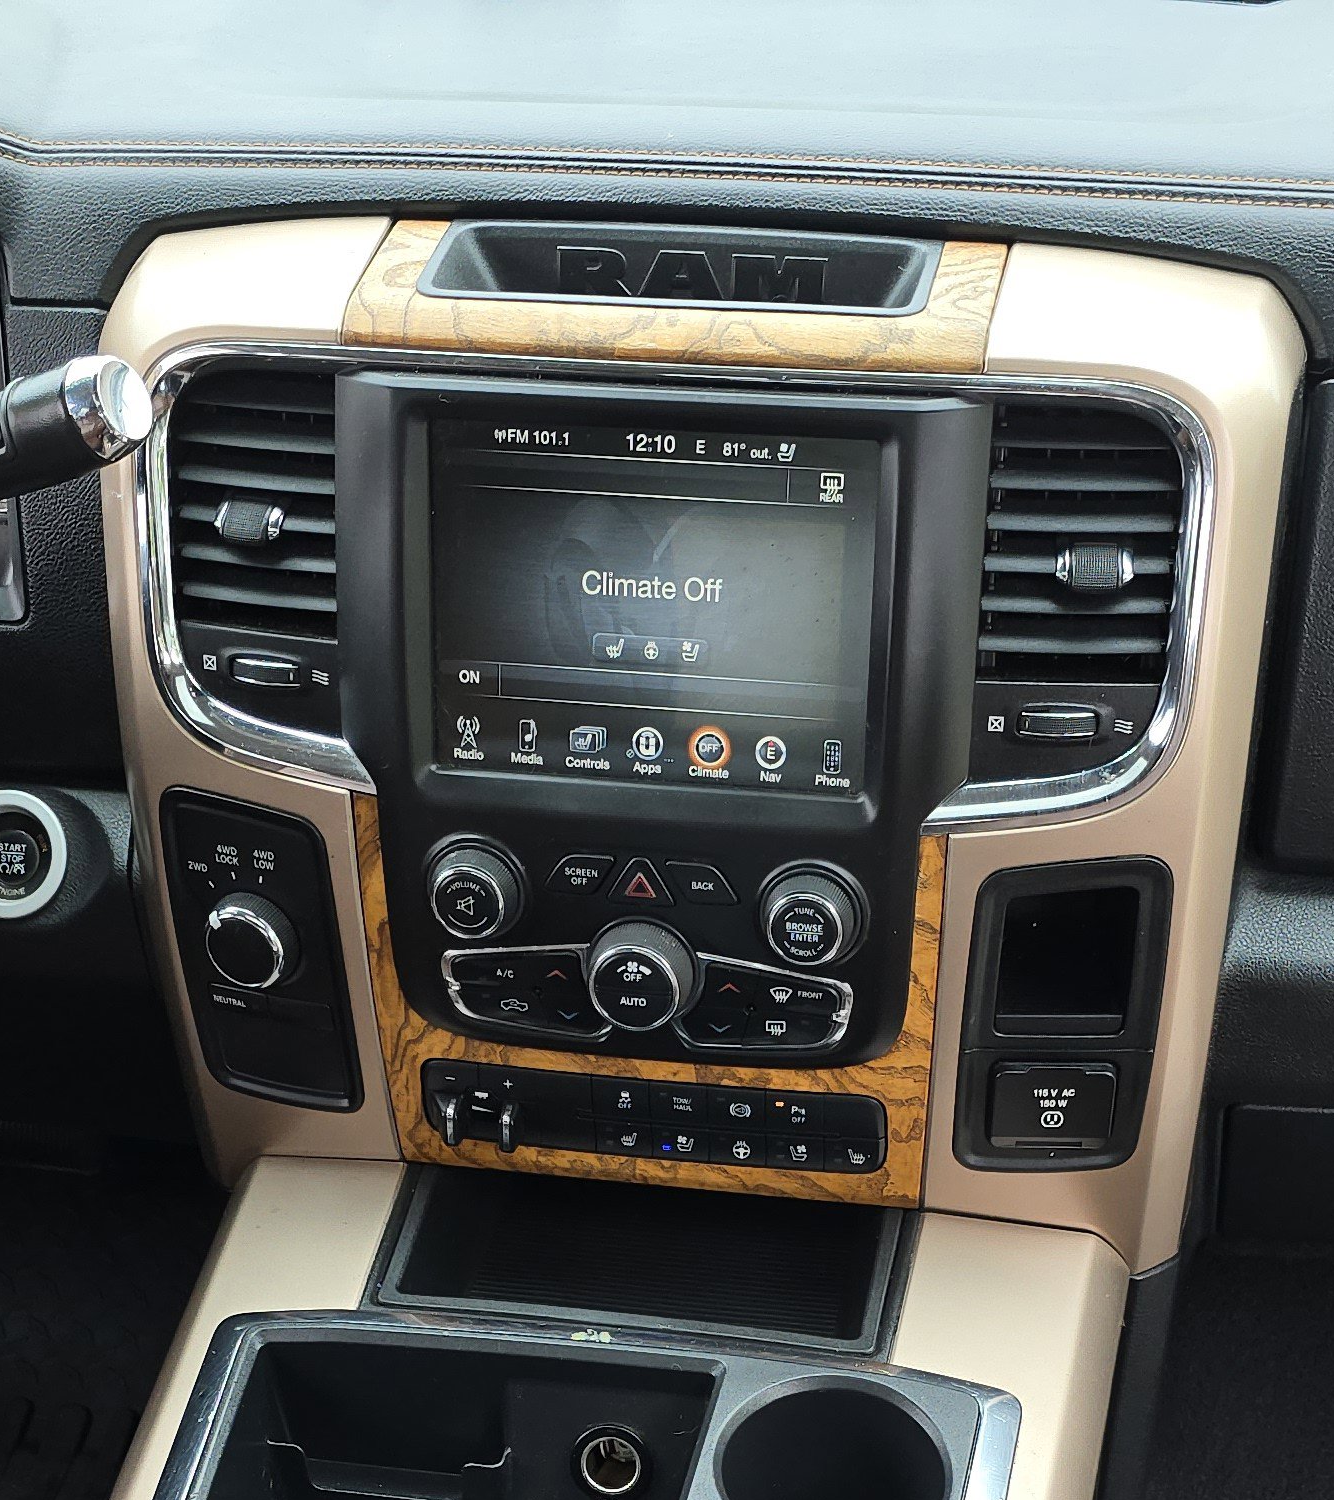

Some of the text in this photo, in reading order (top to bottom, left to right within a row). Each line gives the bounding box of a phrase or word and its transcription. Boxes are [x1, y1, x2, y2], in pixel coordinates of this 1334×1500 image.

[555, 244, 830, 302] RAM
[507, 429, 571, 446] FM 101.1
[625, 433, 676, 453] 12:10
[695, 440, 706, 455] E
[722, 442, 773, 461] 81° out.
[819, 492, 844, 504] REAR
[581, 570, 723, 603] Climate Off
[458, 669, 481, 685] ON
[453, 748, 485, 761] Radio
[698, 743, 719, 754] OFF
[510, 752, 544, 766] Media
[565, 756, 611, 771] Controls
[633, 761, 662, 776] Apps
[688, 765, 730, 780] Climate
[759, 770, 782, 784] Nav
[814, 774, 851, 788] Phone
[216, 844, 238, 856] 4WD
[253, 849, 275, 860] 4WD
[0, 854, 25, 863] STOP
[214, 853, 240, 866] LOCK
[253, 858, 275, 871] LOW
[187, 860, 208, 872] 2WD
[564, 866, 599, 878] SCREEN
[570, 876, 588, 886] OFF
[691, 880, 715, 892] BACK
[449, 881, 481, 894] VOLUME
[793, 907, 815, 917] TUNE
[785, 921, 824, 933] BROWSE
[790, 932, 820, 943] ENTER
[789, 946, 818, 958] SCROLL
[496, 968, 515, 980] A/C
[622, 972, 643, 984] OFF
[212, 994, 247, 1008] NEUTRAL
[619, 995, 647, 1008] AUTO
[797, 990, 824, 1001] FRONT
[1050, 1088, 1058, 1098] V
[1061, 1088, 1076, 1098] AC
[617, 1102, 632, 1110] OFF
[673, 1103, 692, 1112] HAUL
[1057, 1099, 1068, 1108] W
[791, 1116, 806, 1124] OFF
